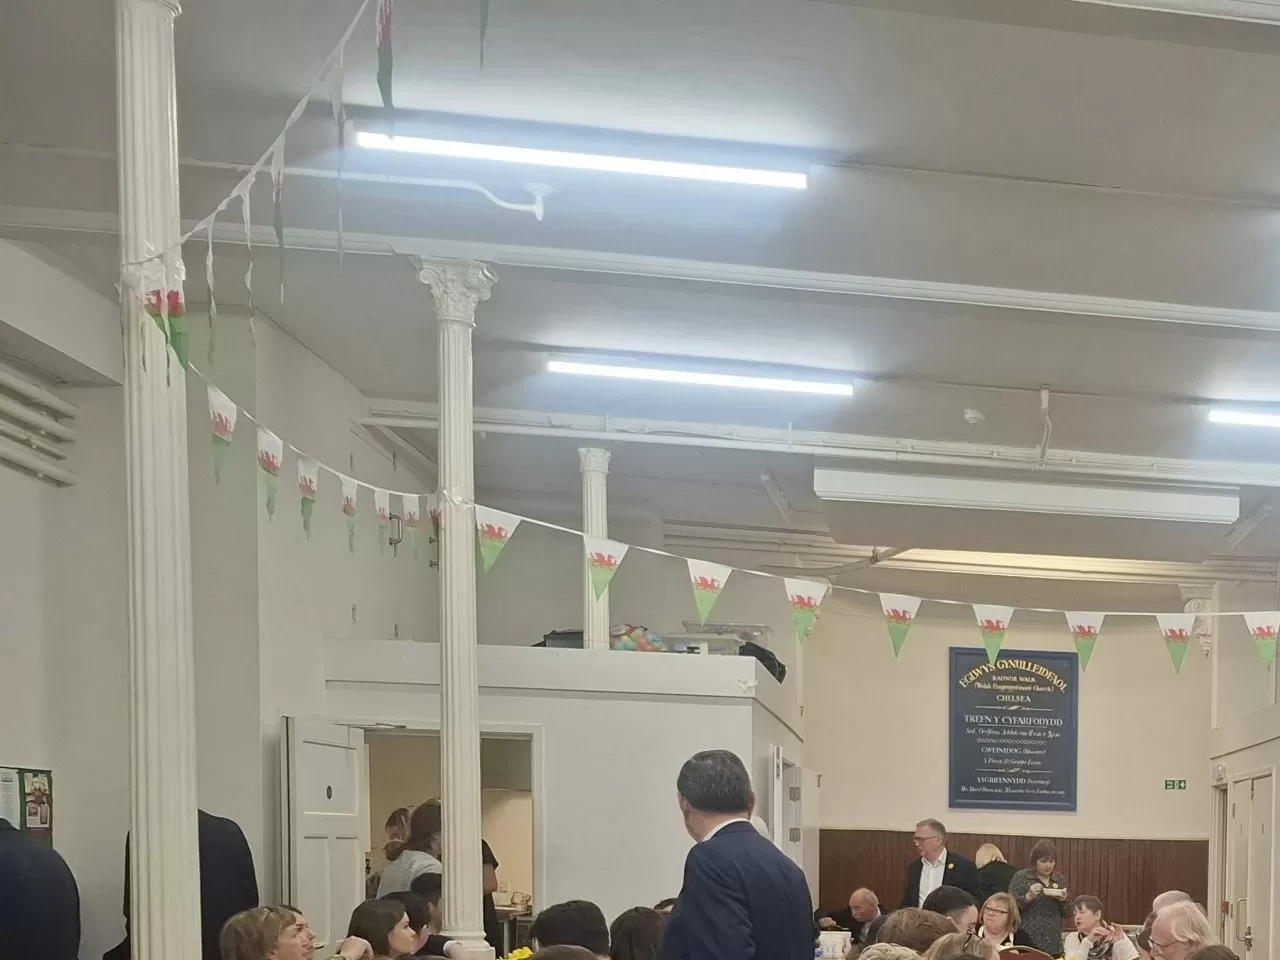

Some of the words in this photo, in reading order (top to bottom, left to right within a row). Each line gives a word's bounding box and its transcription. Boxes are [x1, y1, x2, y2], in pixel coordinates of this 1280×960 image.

[996, 695, 1031, 703] CHELSEA
[964, 714, 991, 723] TREFN
[993, 715, 1000, 724] Y
